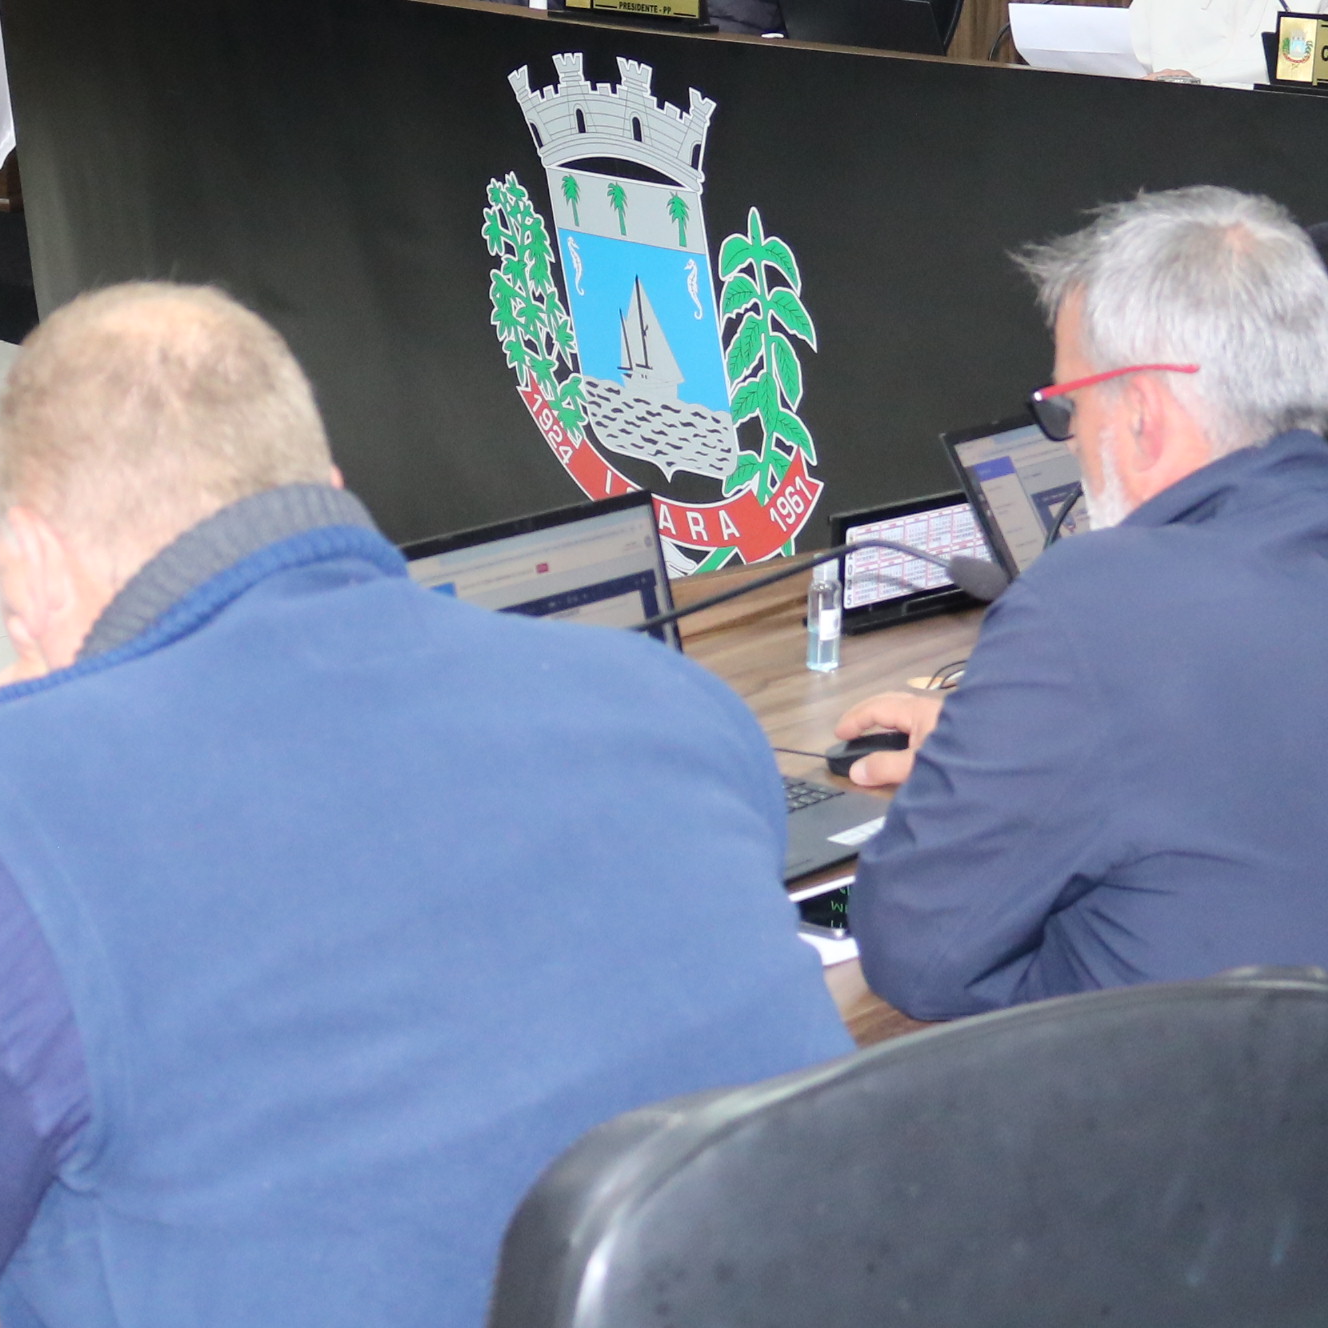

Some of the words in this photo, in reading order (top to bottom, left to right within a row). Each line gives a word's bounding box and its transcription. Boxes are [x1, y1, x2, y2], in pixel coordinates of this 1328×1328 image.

[618, 1, 658, 14] PRESIDENTE
[662, 5, 672, 15] PP
[532, 393, 573, 465] 1924
[605, 471, 740, 541] IARA
[770, 484, 813, 532] 1961
